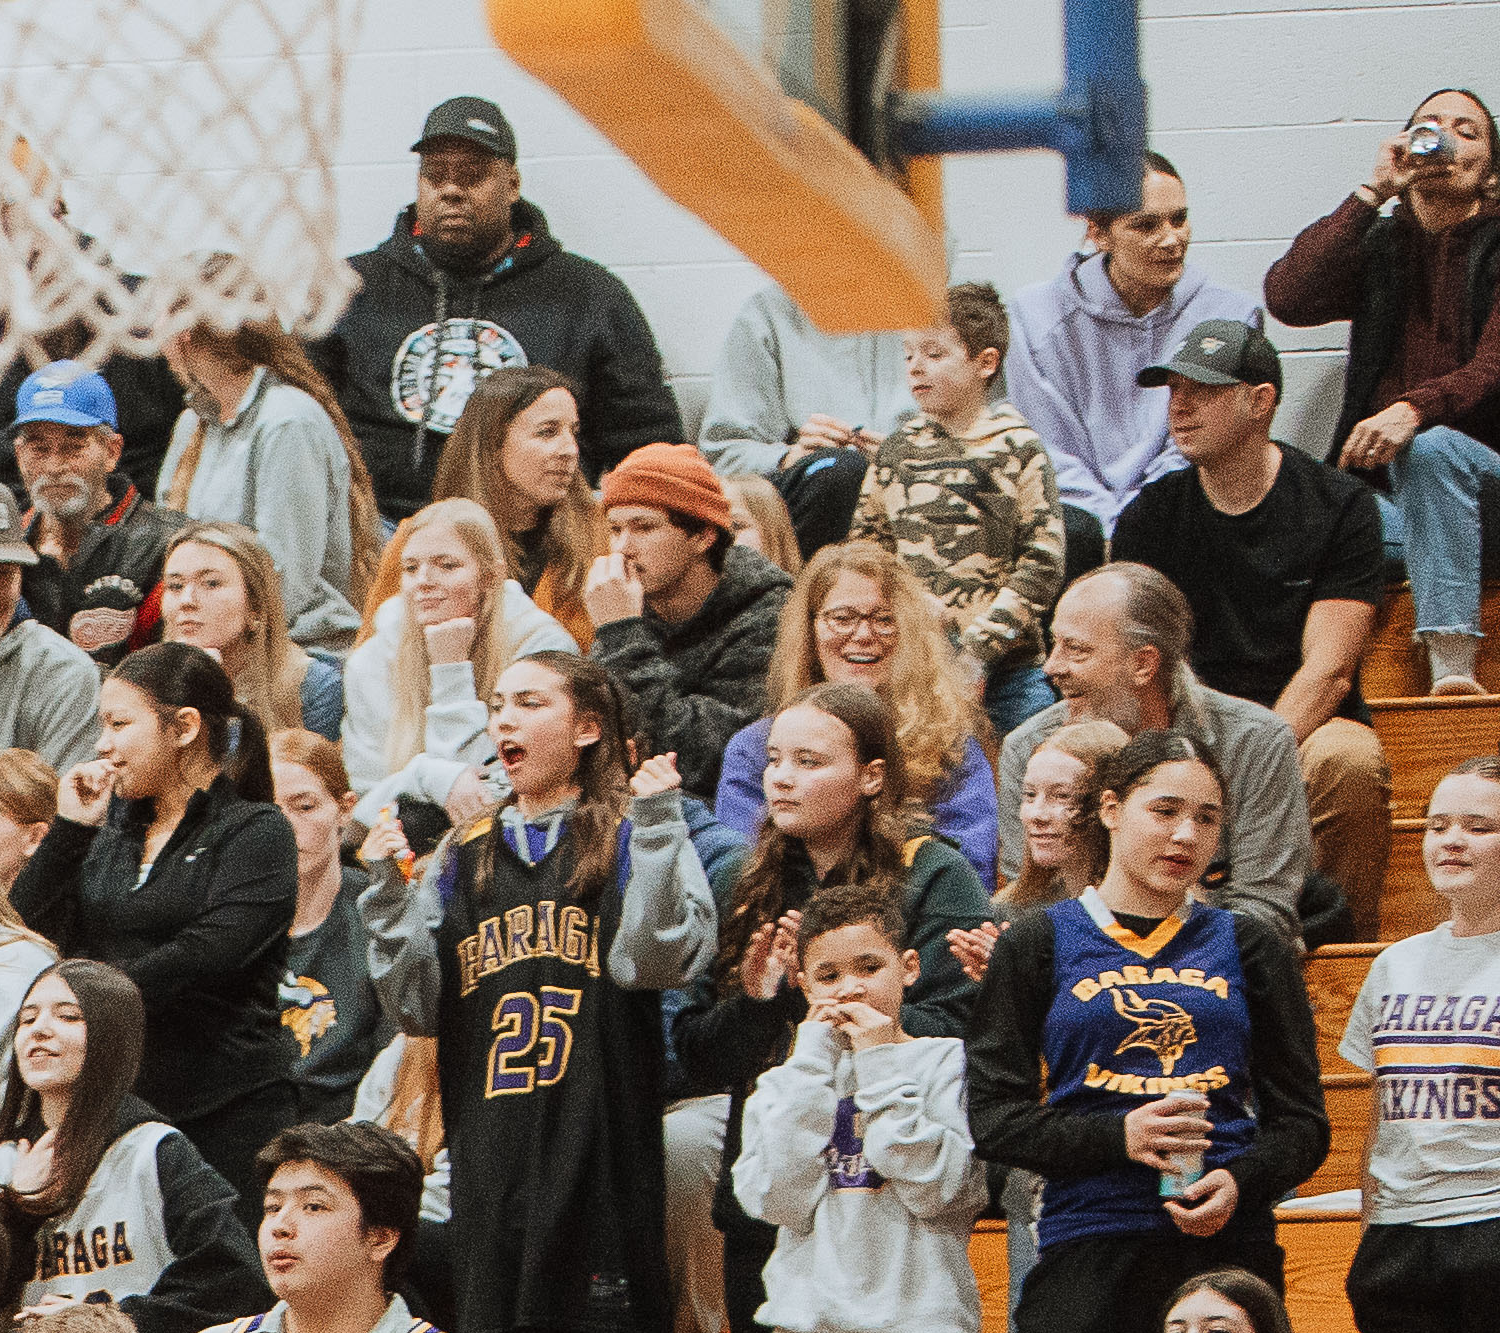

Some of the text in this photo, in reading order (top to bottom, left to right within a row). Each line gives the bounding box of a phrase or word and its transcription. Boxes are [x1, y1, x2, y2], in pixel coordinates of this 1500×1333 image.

[1072, 965, 1229, 1001] BARAGA
[484, 985, 583, 1099] 25
[1084, 1063, 1231, 1095] VIKINGS
